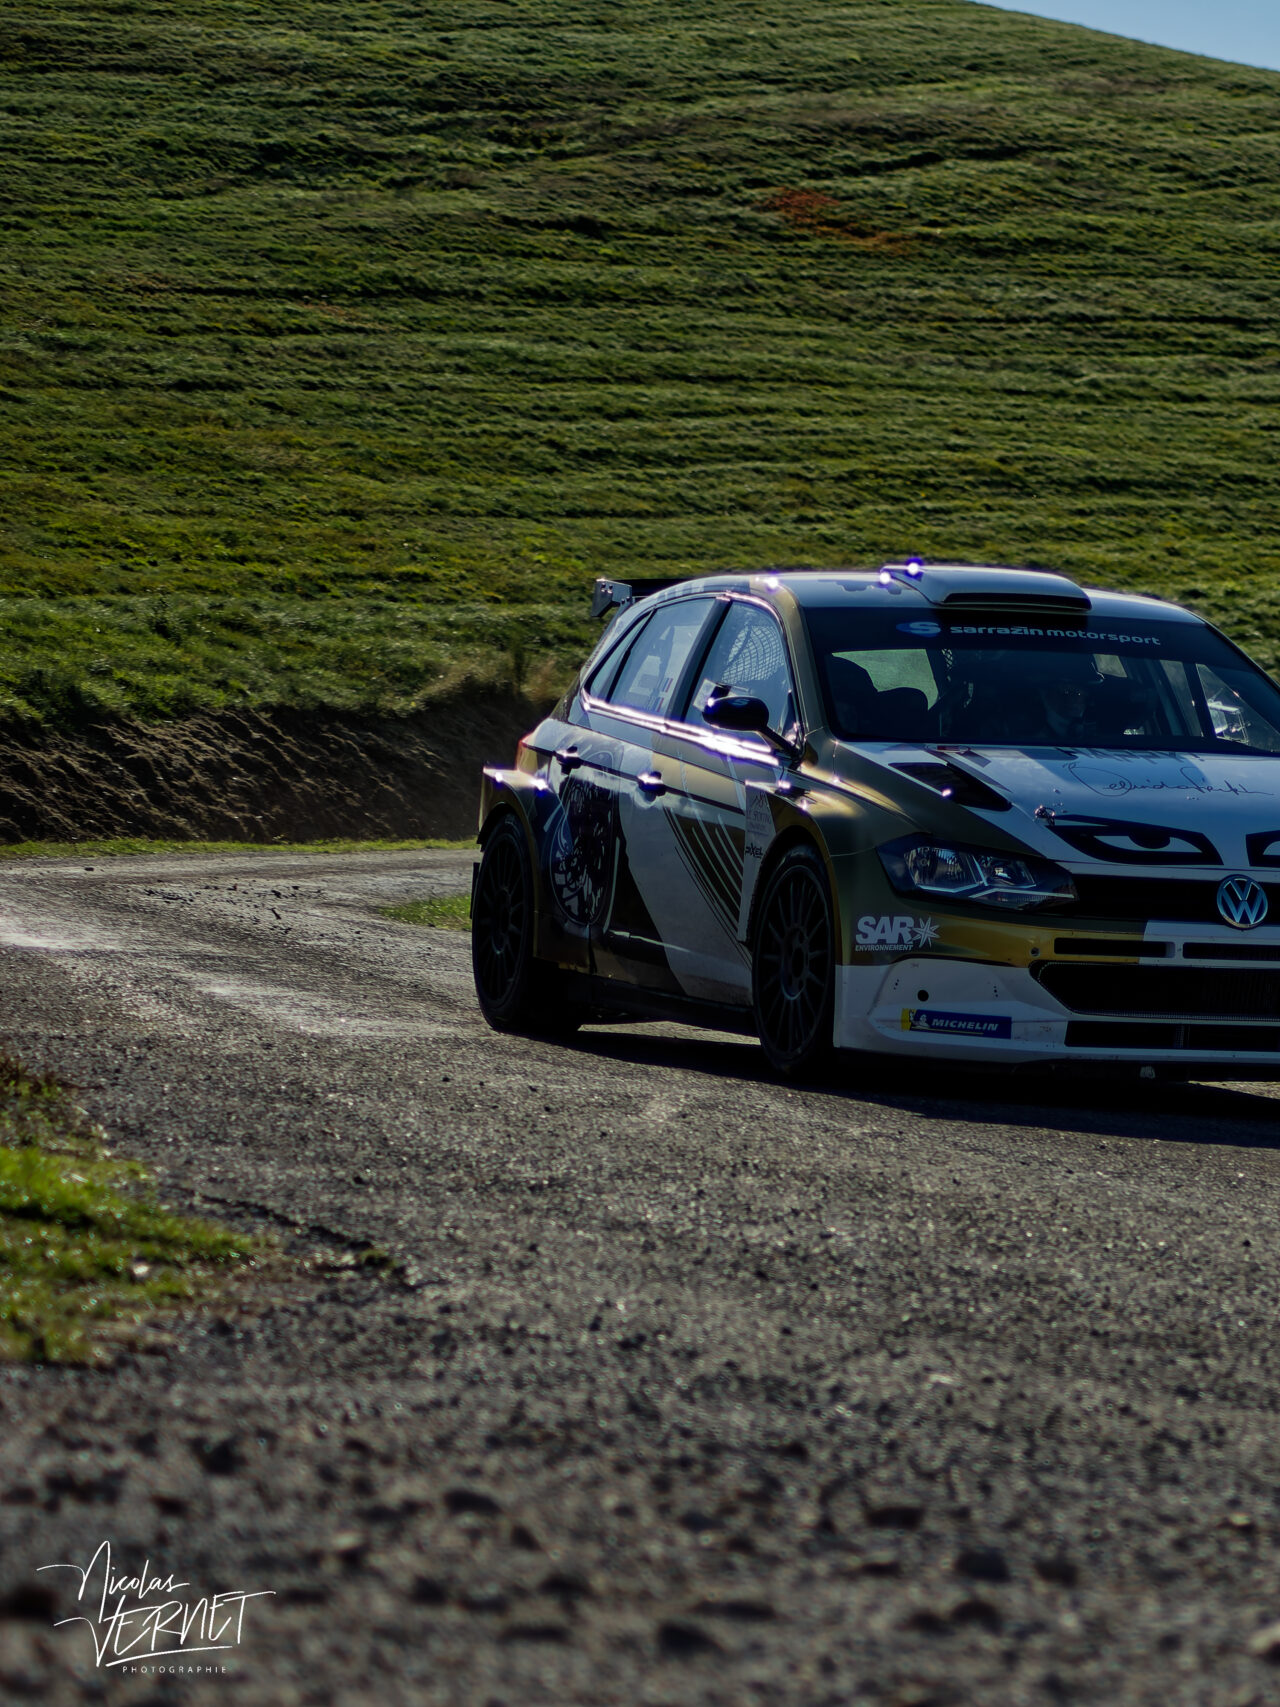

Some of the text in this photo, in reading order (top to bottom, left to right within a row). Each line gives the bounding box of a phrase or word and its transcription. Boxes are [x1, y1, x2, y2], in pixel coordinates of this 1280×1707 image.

[949, 624, 1162, 646] sarrazin motorsport
[855, 915, 915, 944] SAR
[855, 944, 914, 952] ENVIRONNEMENT
[931, 1018, 999, 1032] MICHELIN
